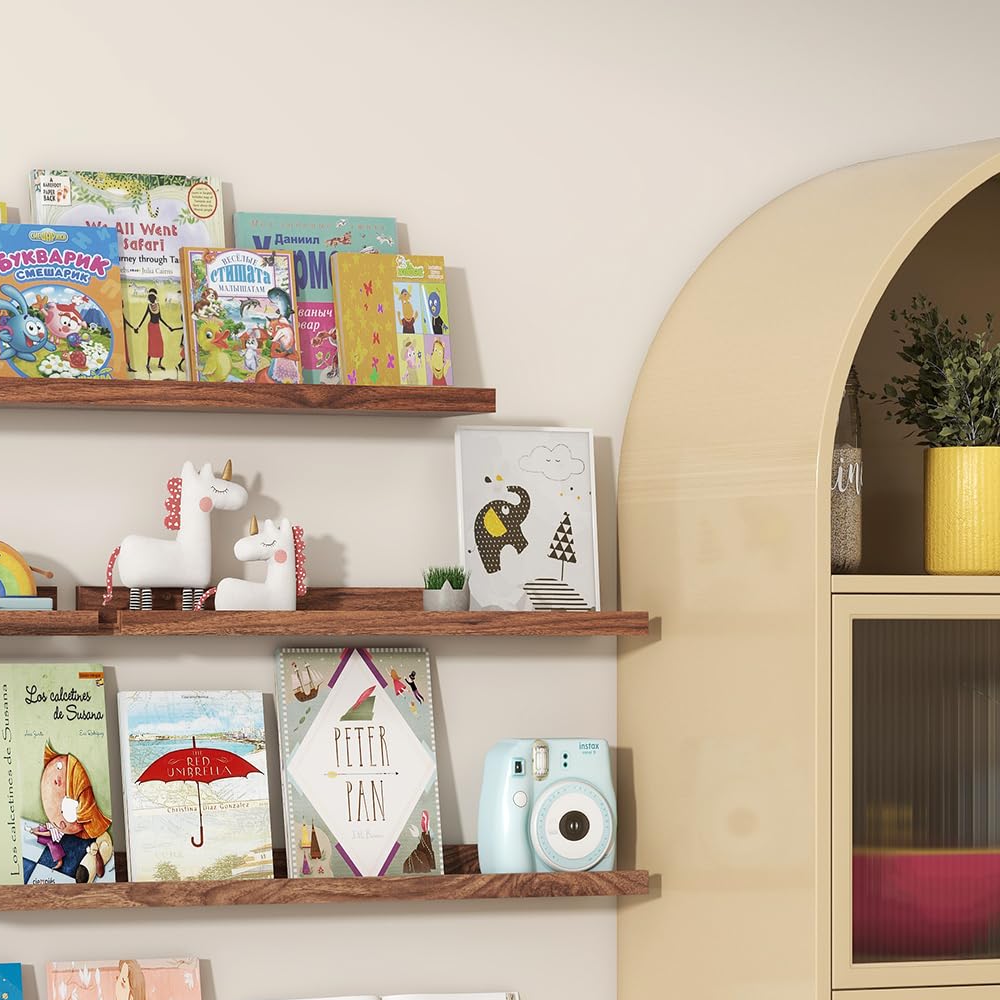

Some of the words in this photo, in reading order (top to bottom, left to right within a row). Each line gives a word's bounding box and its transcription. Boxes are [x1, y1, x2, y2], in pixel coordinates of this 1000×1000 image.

[116, 221, 135, 236] All
[140, 222, 179, 237] Went
[122, 239, 165, 252] Safari
[275, 233, 320, 246] Даниил
[139, 255, 168, 266] through
[16, 267, 90, 283] СМЕШАРИК
[297, 308, 333, 318] ваныч
[25, 685, 48, 705] Los
[49, 686, 92, 702] calcetines
[1, 684, 13, 743] Susana
[53, 705, 65, 720] de
[66, 704, 104, 721] Susana
[333, 725, 390, 768] PETER
[578, 741, 600, 750] instax
[3, 747, 13, 765] de
[186, 756, 211, 767] RED
[167, 765, 232, 778] UMBRELLA
[6, 769, 19, 843] calcetines
[345, 780, 387, 822] PAN
[167, 805, 198, 814] Christina
[11, 846, 20, 876] Los
